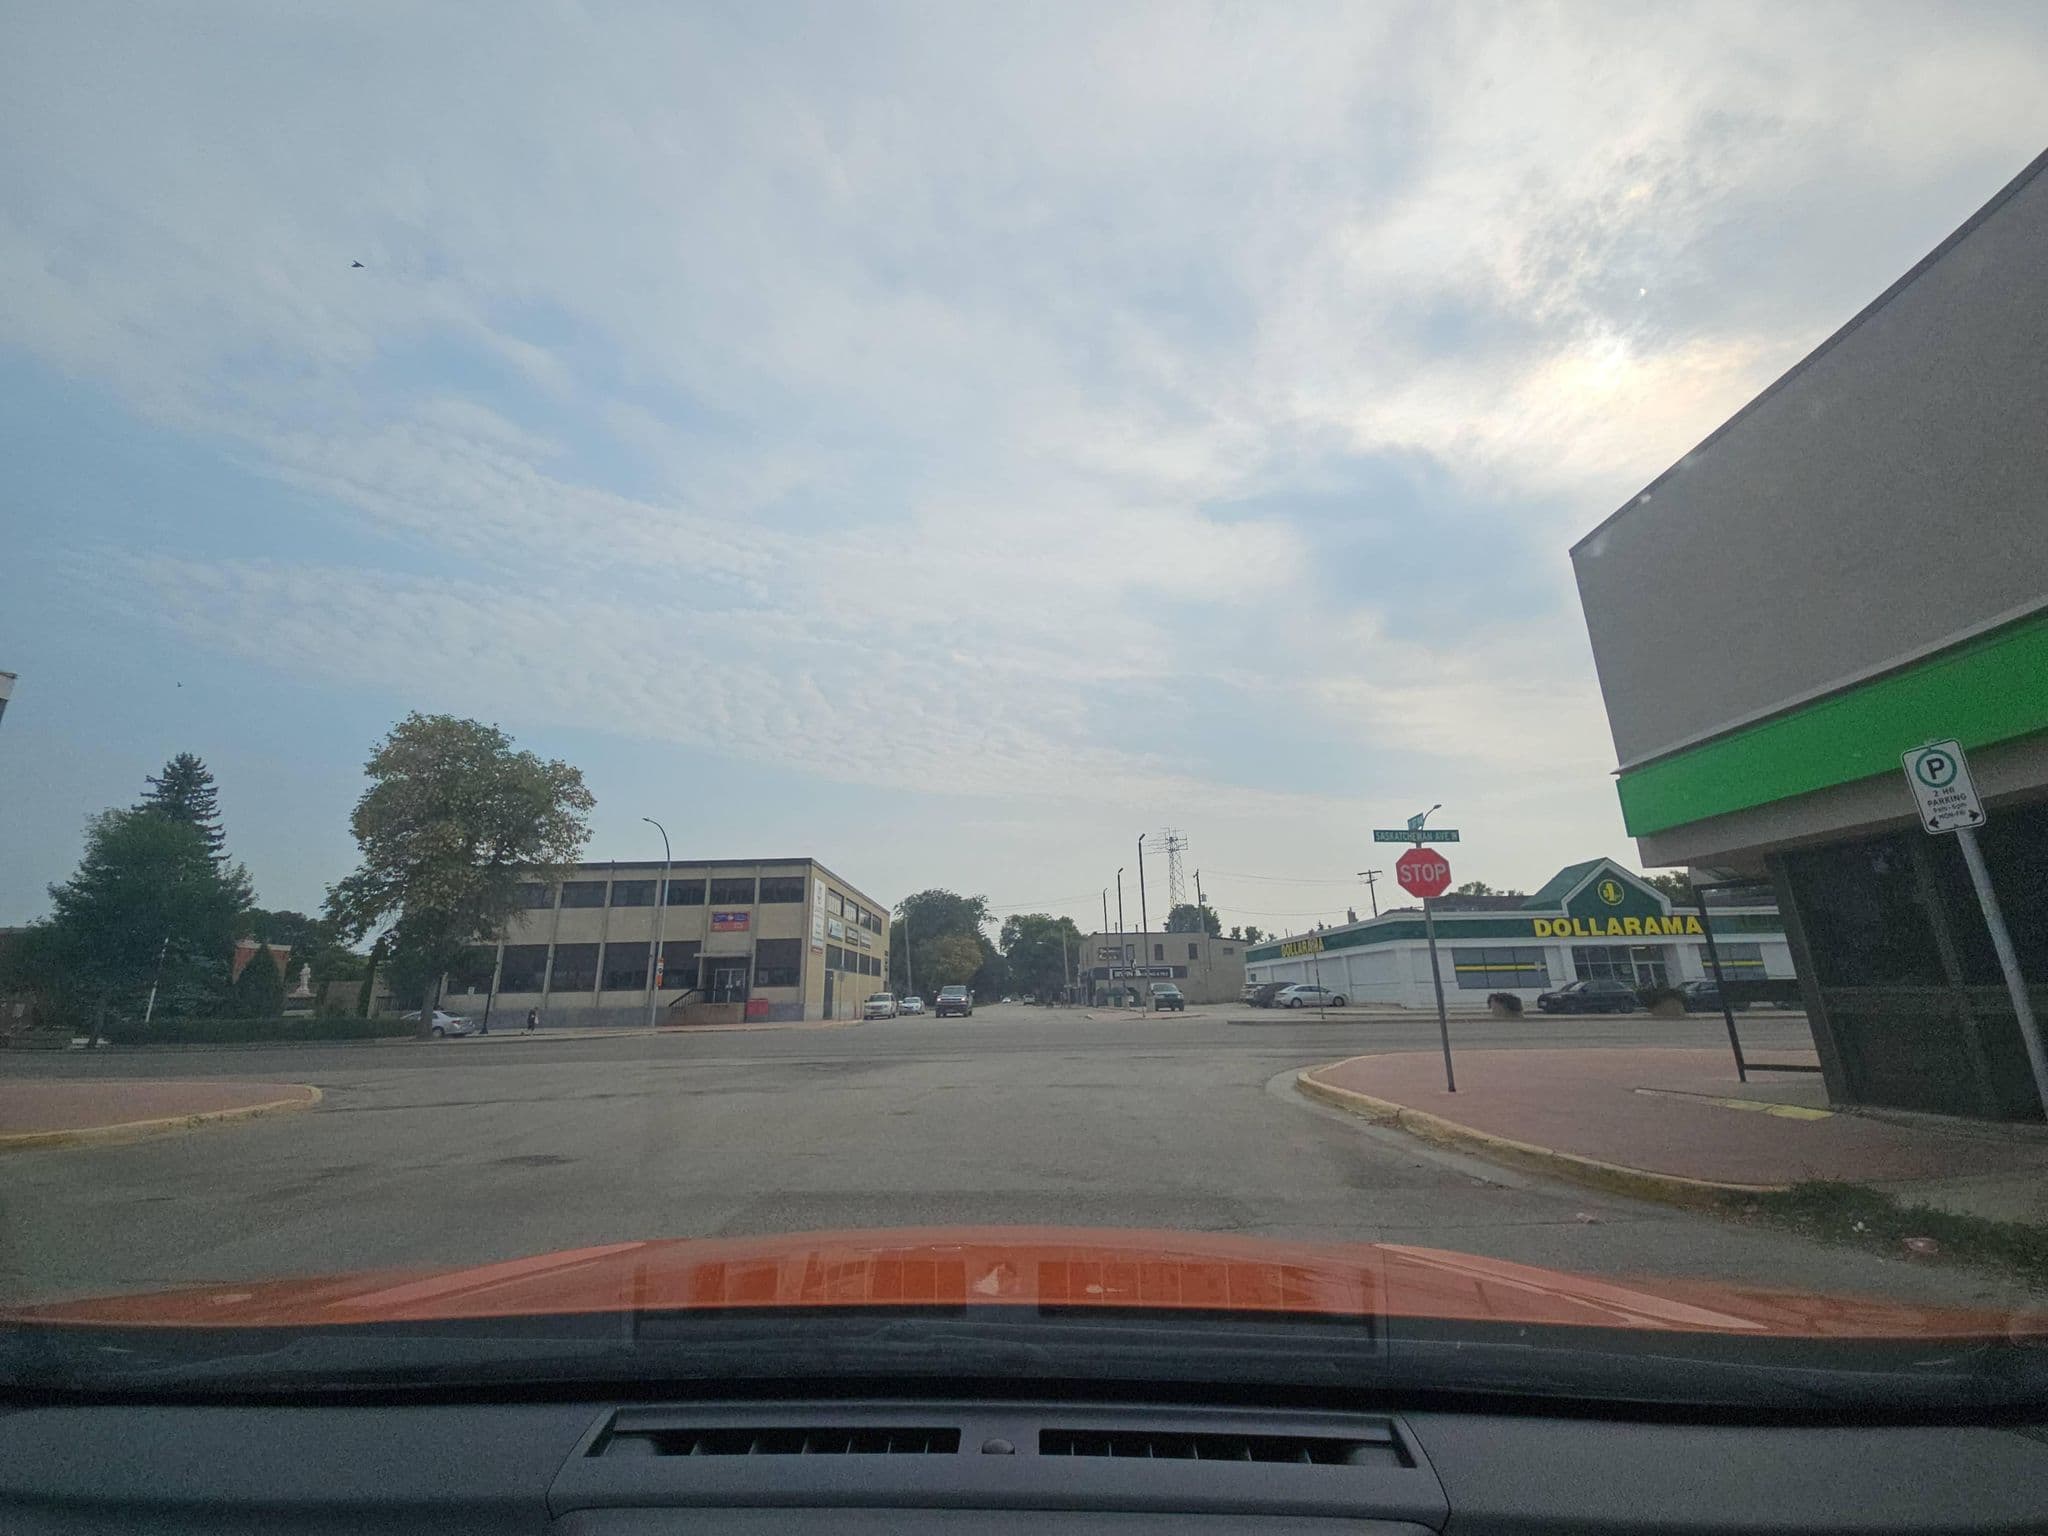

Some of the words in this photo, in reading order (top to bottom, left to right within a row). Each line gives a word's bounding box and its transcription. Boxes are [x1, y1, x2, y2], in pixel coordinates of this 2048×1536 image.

[1926, 758, 1945, 780] P
[1927, 793, 1967, 806] PARKING
[1933, 790, 1940, 798] 2
[1375, 831, 1433, 841] SASKATCHEWAN
[1434, 831, 1450, 841] AVE
[1400, 863, 1446, 882] STOP
[1533, 916, 1704, 937] DOLLARAMA
